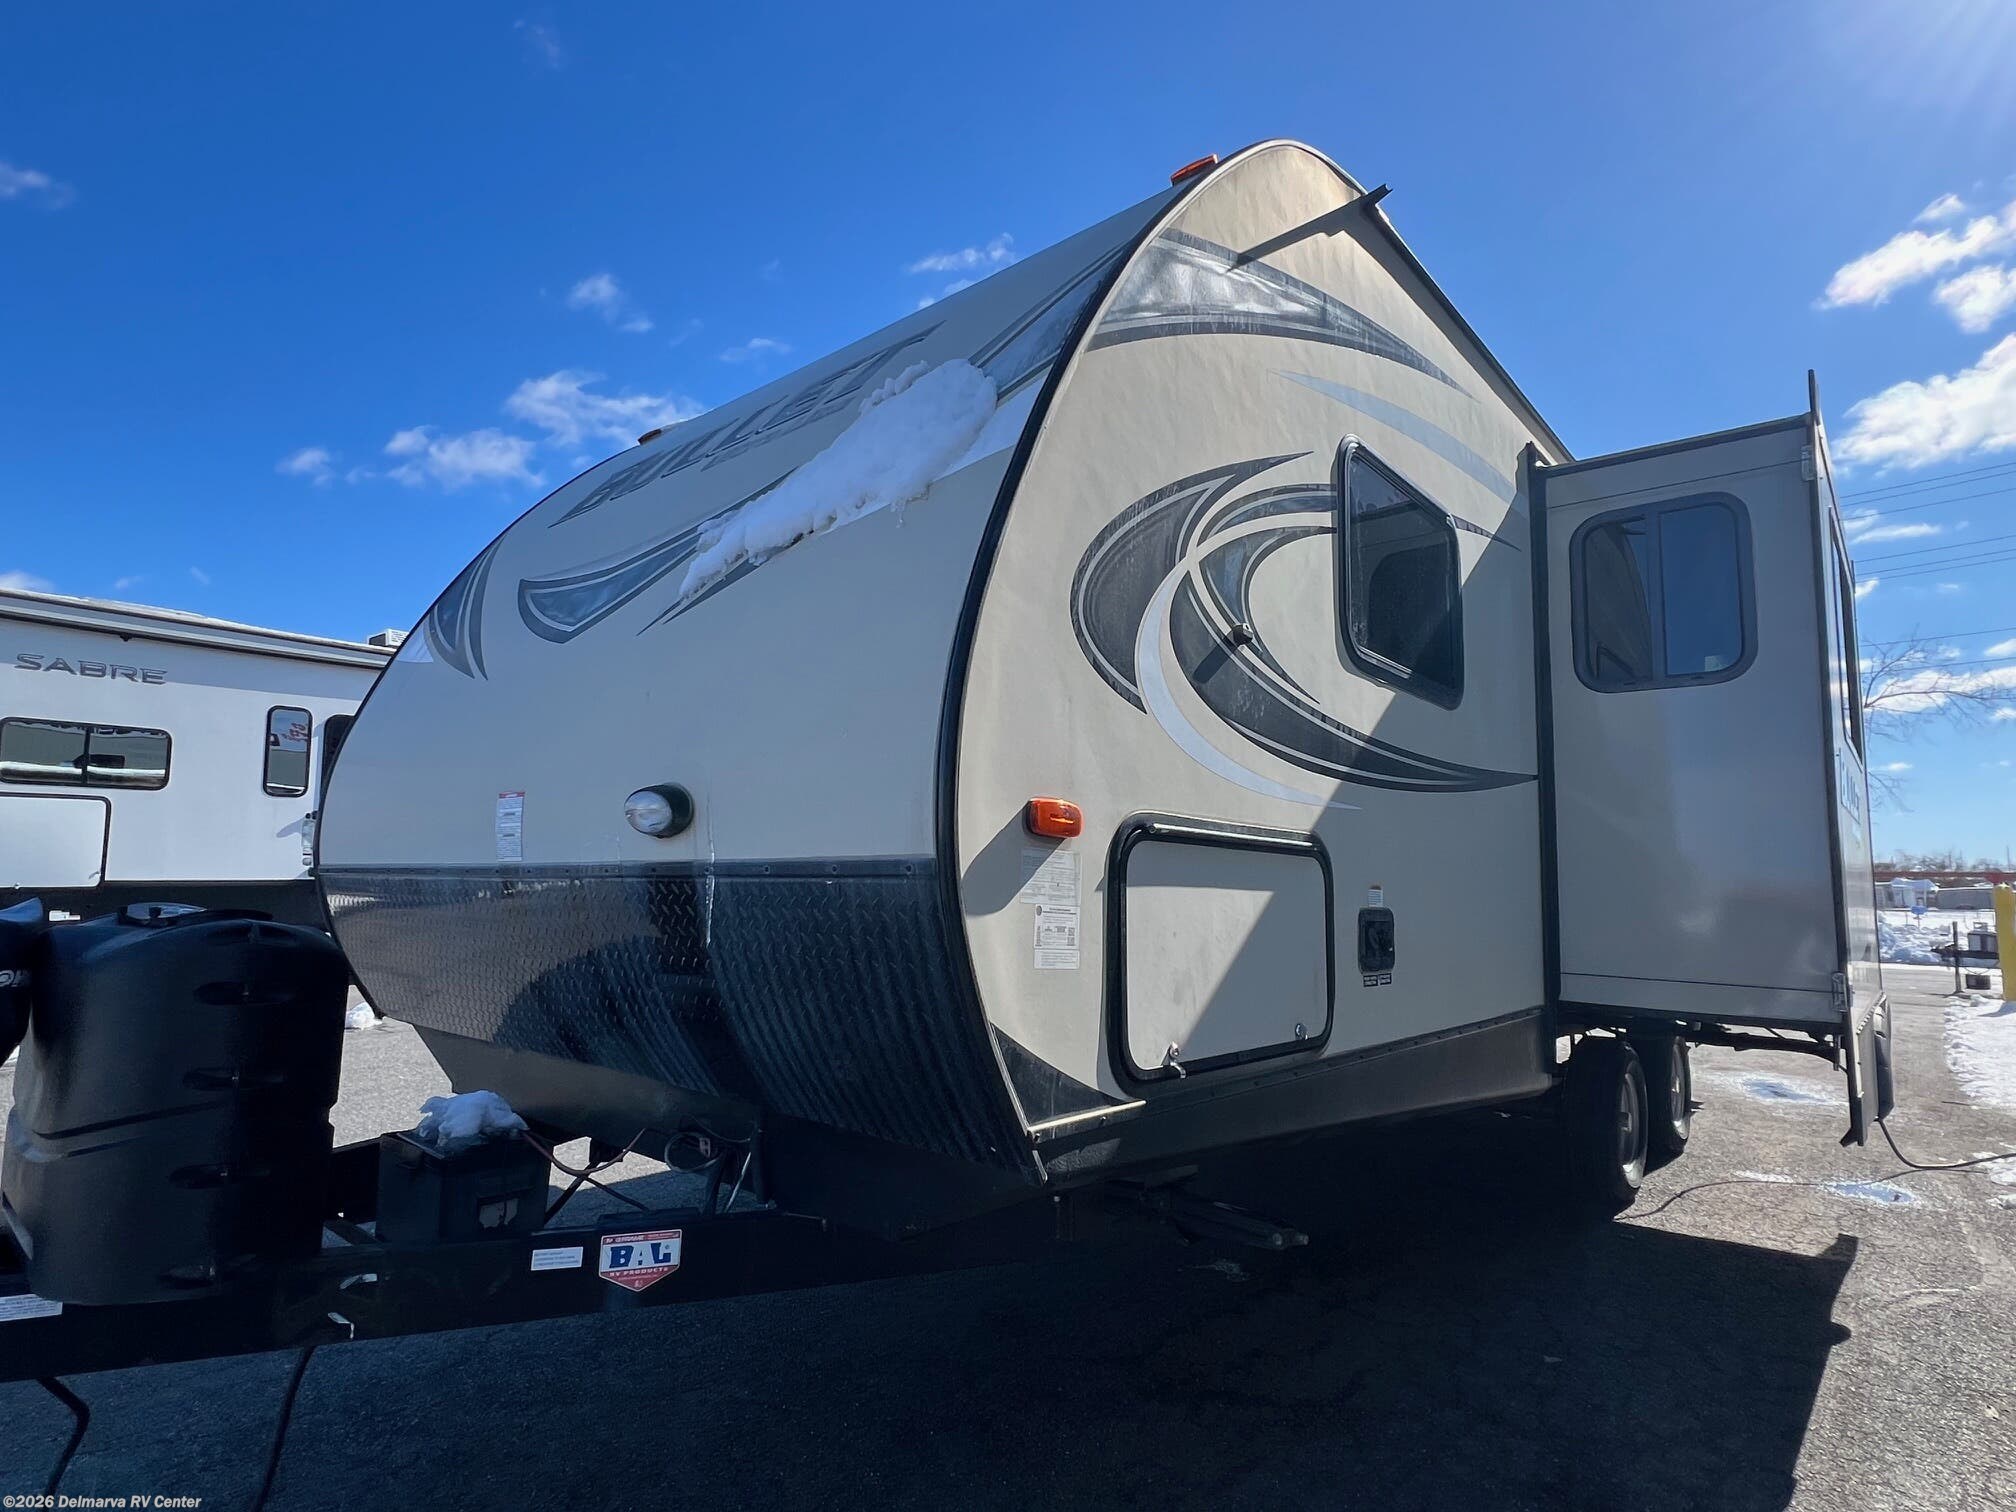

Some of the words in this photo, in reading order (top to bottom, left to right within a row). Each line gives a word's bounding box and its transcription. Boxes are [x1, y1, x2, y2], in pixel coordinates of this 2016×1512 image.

[14, 653, 168, 685] SABRE
[609, 1242, 672, 1268] BAL
[623, 1267, 669, 1276] PRODUCTS
